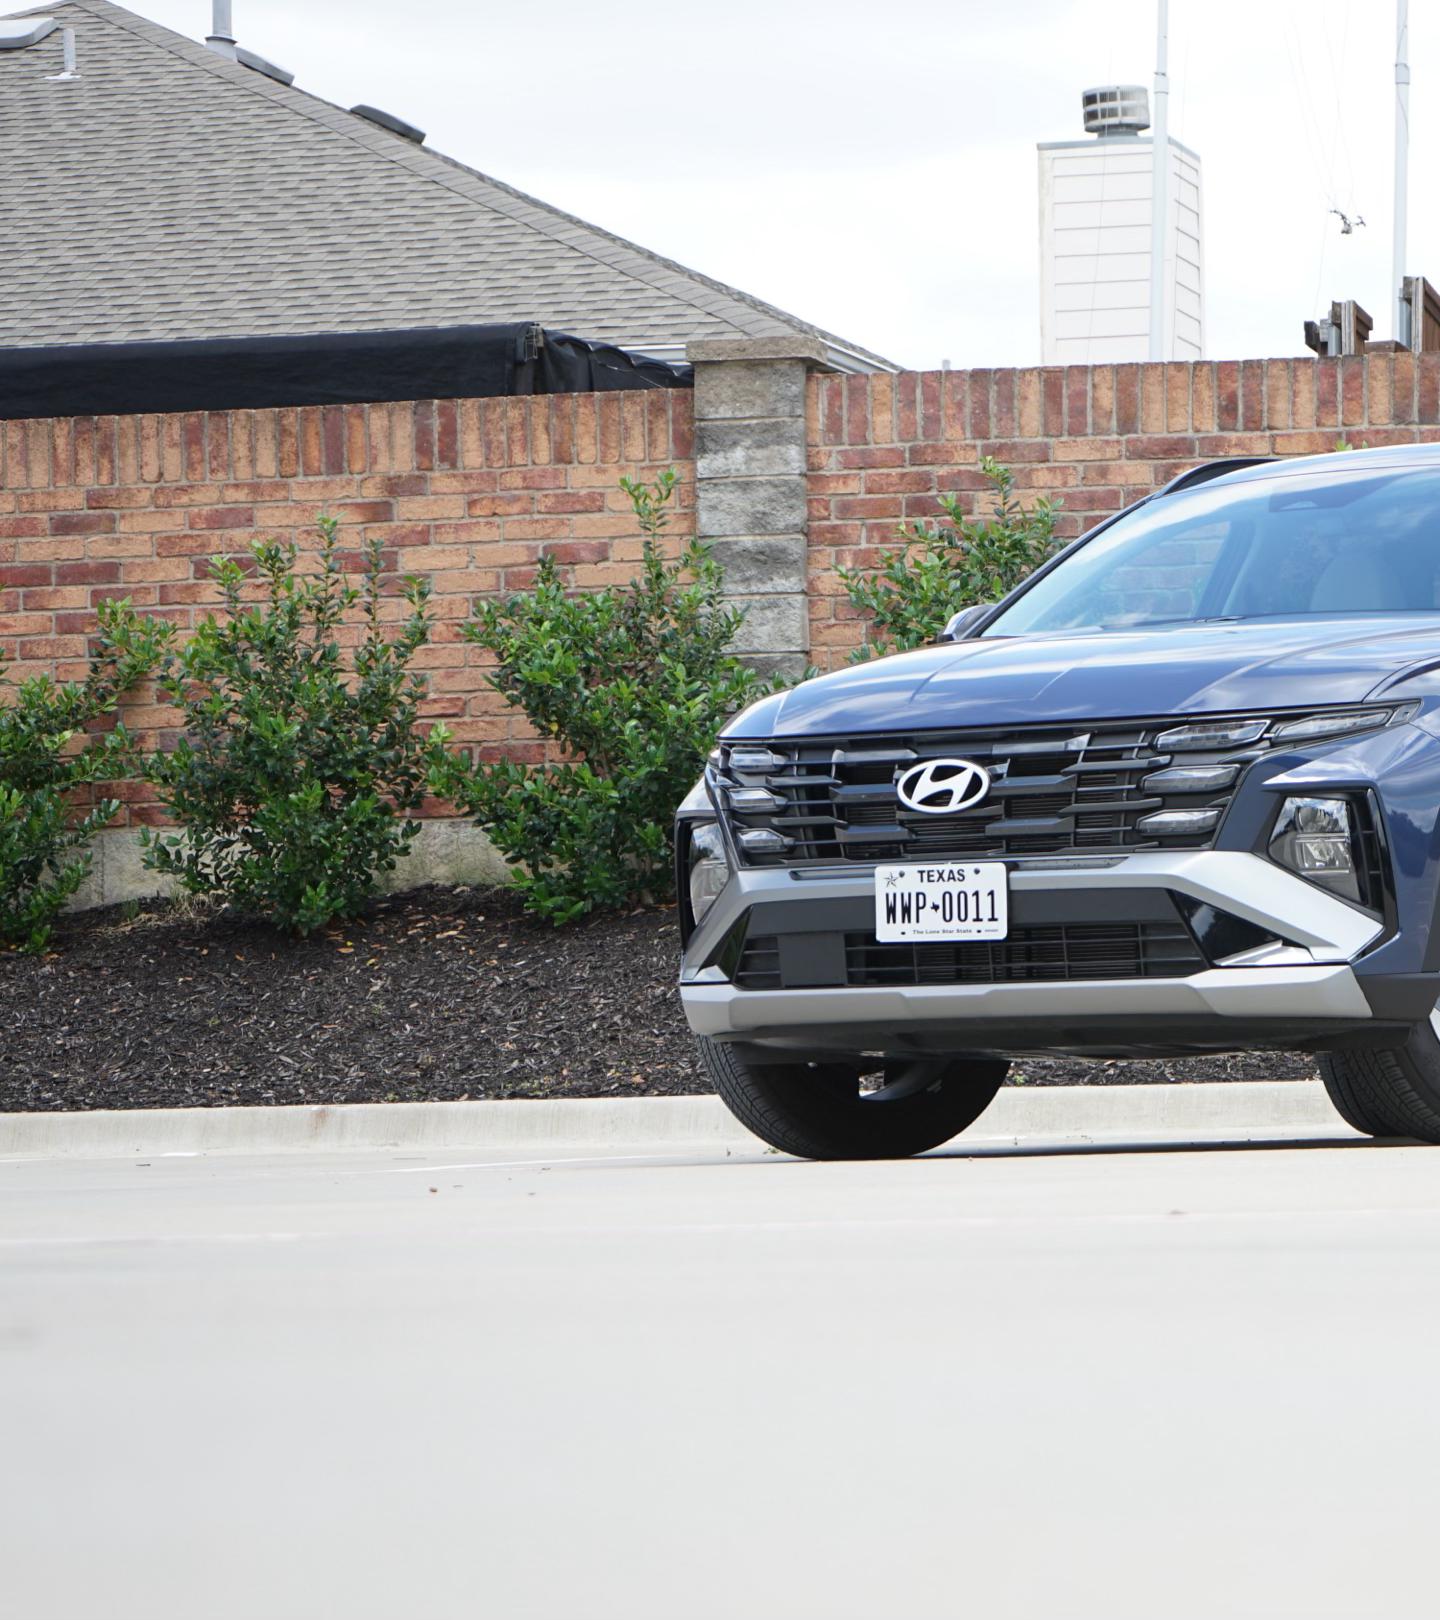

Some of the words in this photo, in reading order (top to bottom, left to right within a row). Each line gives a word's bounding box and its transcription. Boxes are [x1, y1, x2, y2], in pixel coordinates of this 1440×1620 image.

[918, 869, 965, 882] TEXAS
[886, 892, 926, 924] WWP
[942, 889, 998, 922] 0011
